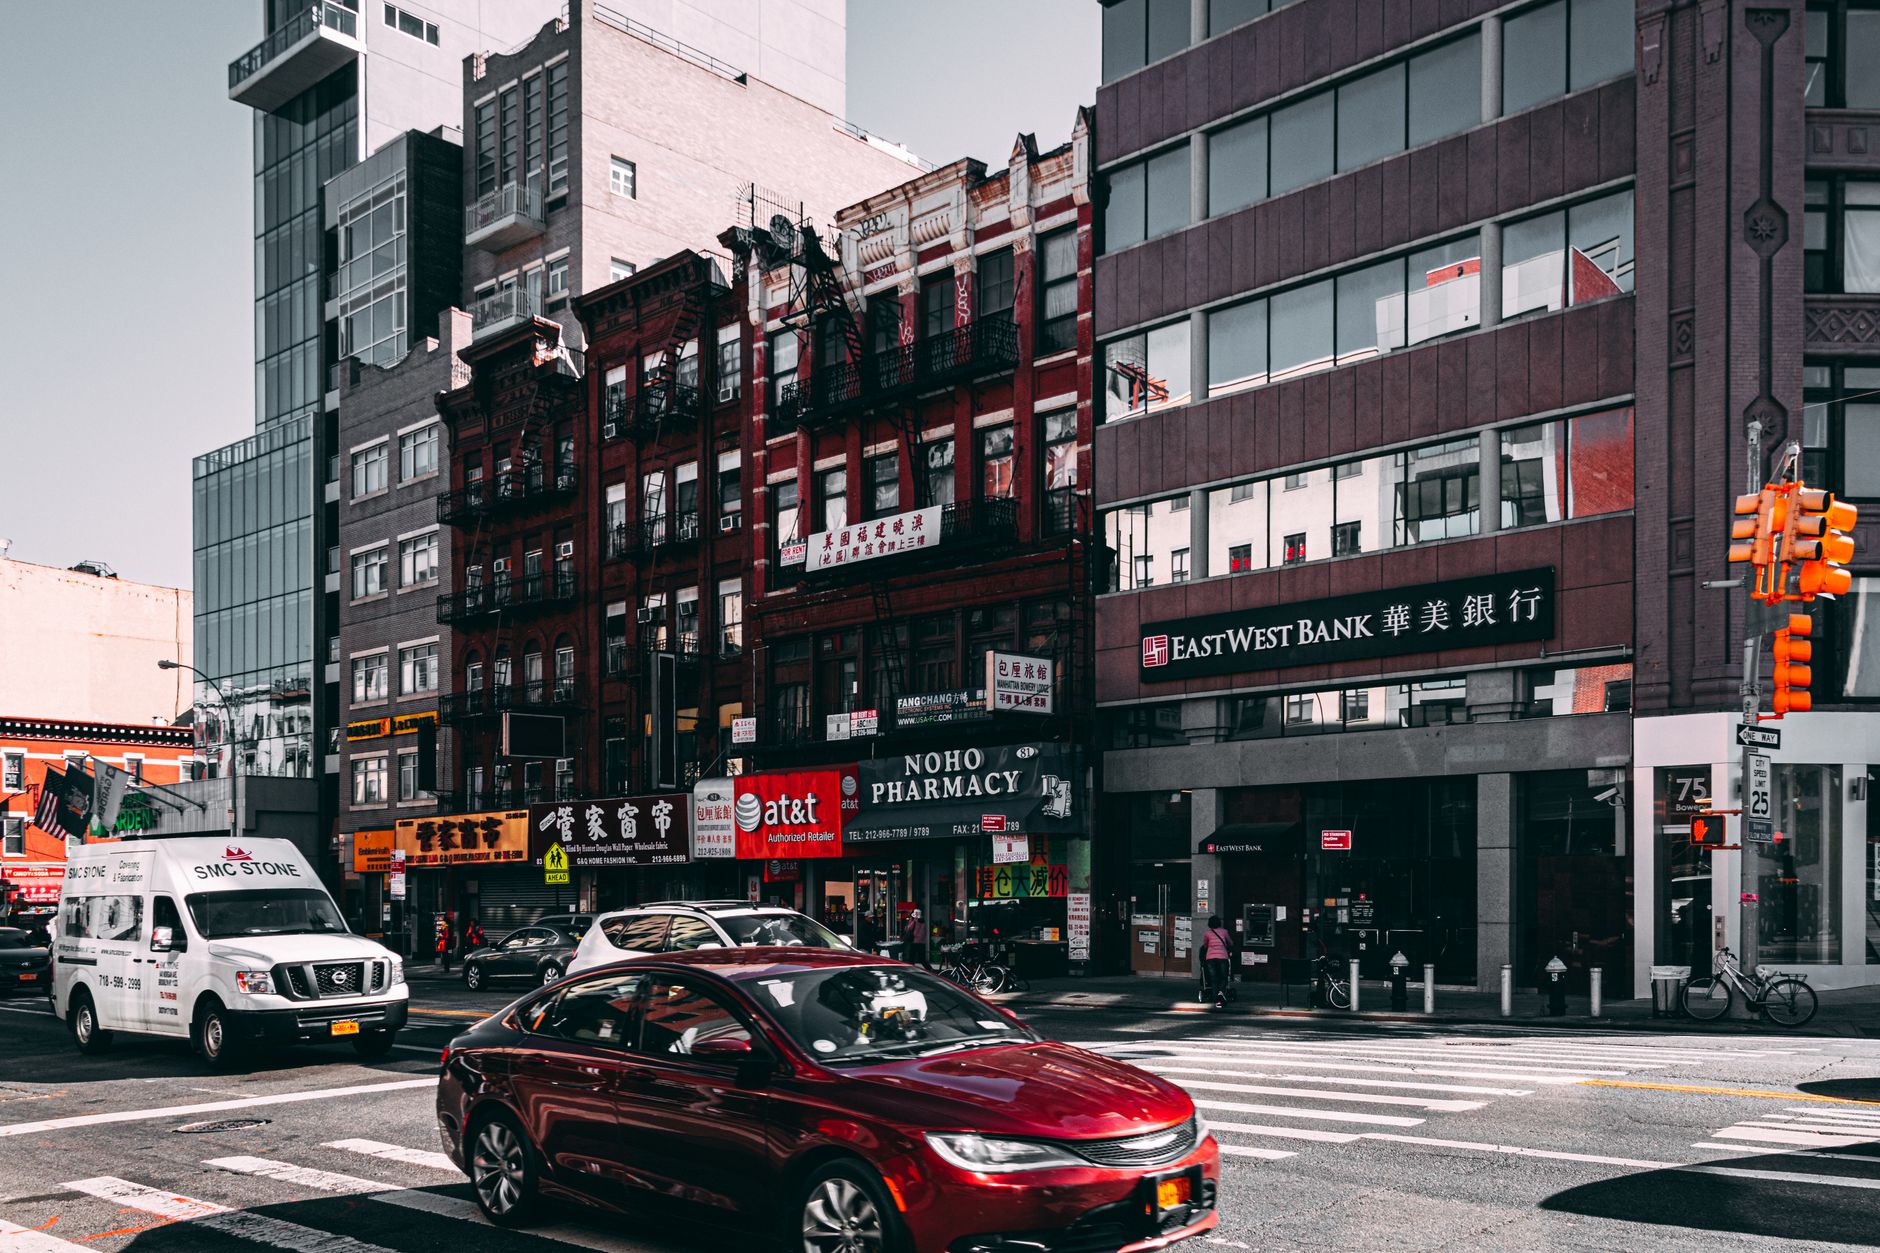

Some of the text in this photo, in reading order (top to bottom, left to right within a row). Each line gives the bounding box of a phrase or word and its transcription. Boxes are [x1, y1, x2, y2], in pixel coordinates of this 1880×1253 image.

[1381, 587, 1542, 636] 華美銀行
[1297, 614, 1374, 645] BANK
[998, 660, 1047, 681] 包厘旅館
[997, 679, 1050, 694] MANHATTAN BOWERY LODGE
[897, 693, 951, 708] FANGCHANG
[1743, 731, 1776, 743] ONE WAY
[1019, 748, 1031, 759] 81
[904, 748, 982, 776] NOHO
[1755, 759, 1765, 767] CITY
[1753, 769, 1767, 778] SPEED
[871, 771, 1019, 804] PHARMACY
[1676, 777, 1707, 801] 75
[1755, 780, 1766, 788] LIMIT
[709, 793, 719, 801] 81
[841, 798, 859, 809] at&t
[1751, 790, 1769, 816] 25
[697, 805, 732, 821] 包厘旅館
[764, 792, 817, 826] at&t
[556, 799, 674, 842] 管家窗帘
[849, 831, 863, 840] TEL:
[865, 828, 908, 840] 212-966-7789
[913, 827, 930, 836] 9789
[953, 824, 970, 834] FAX:
[768, 831, 835, 843] Authorized Retailer
[596, 843, 613, 854] Douglas
[634, 841, 656, 851] Wholesale
[588, 857, 603, 865] HOME
[68, 866, 106, 879] SMC STONE
[195, 861, 301, 879] SMC STONE
[547, 873, 567, 881] AHEAD
